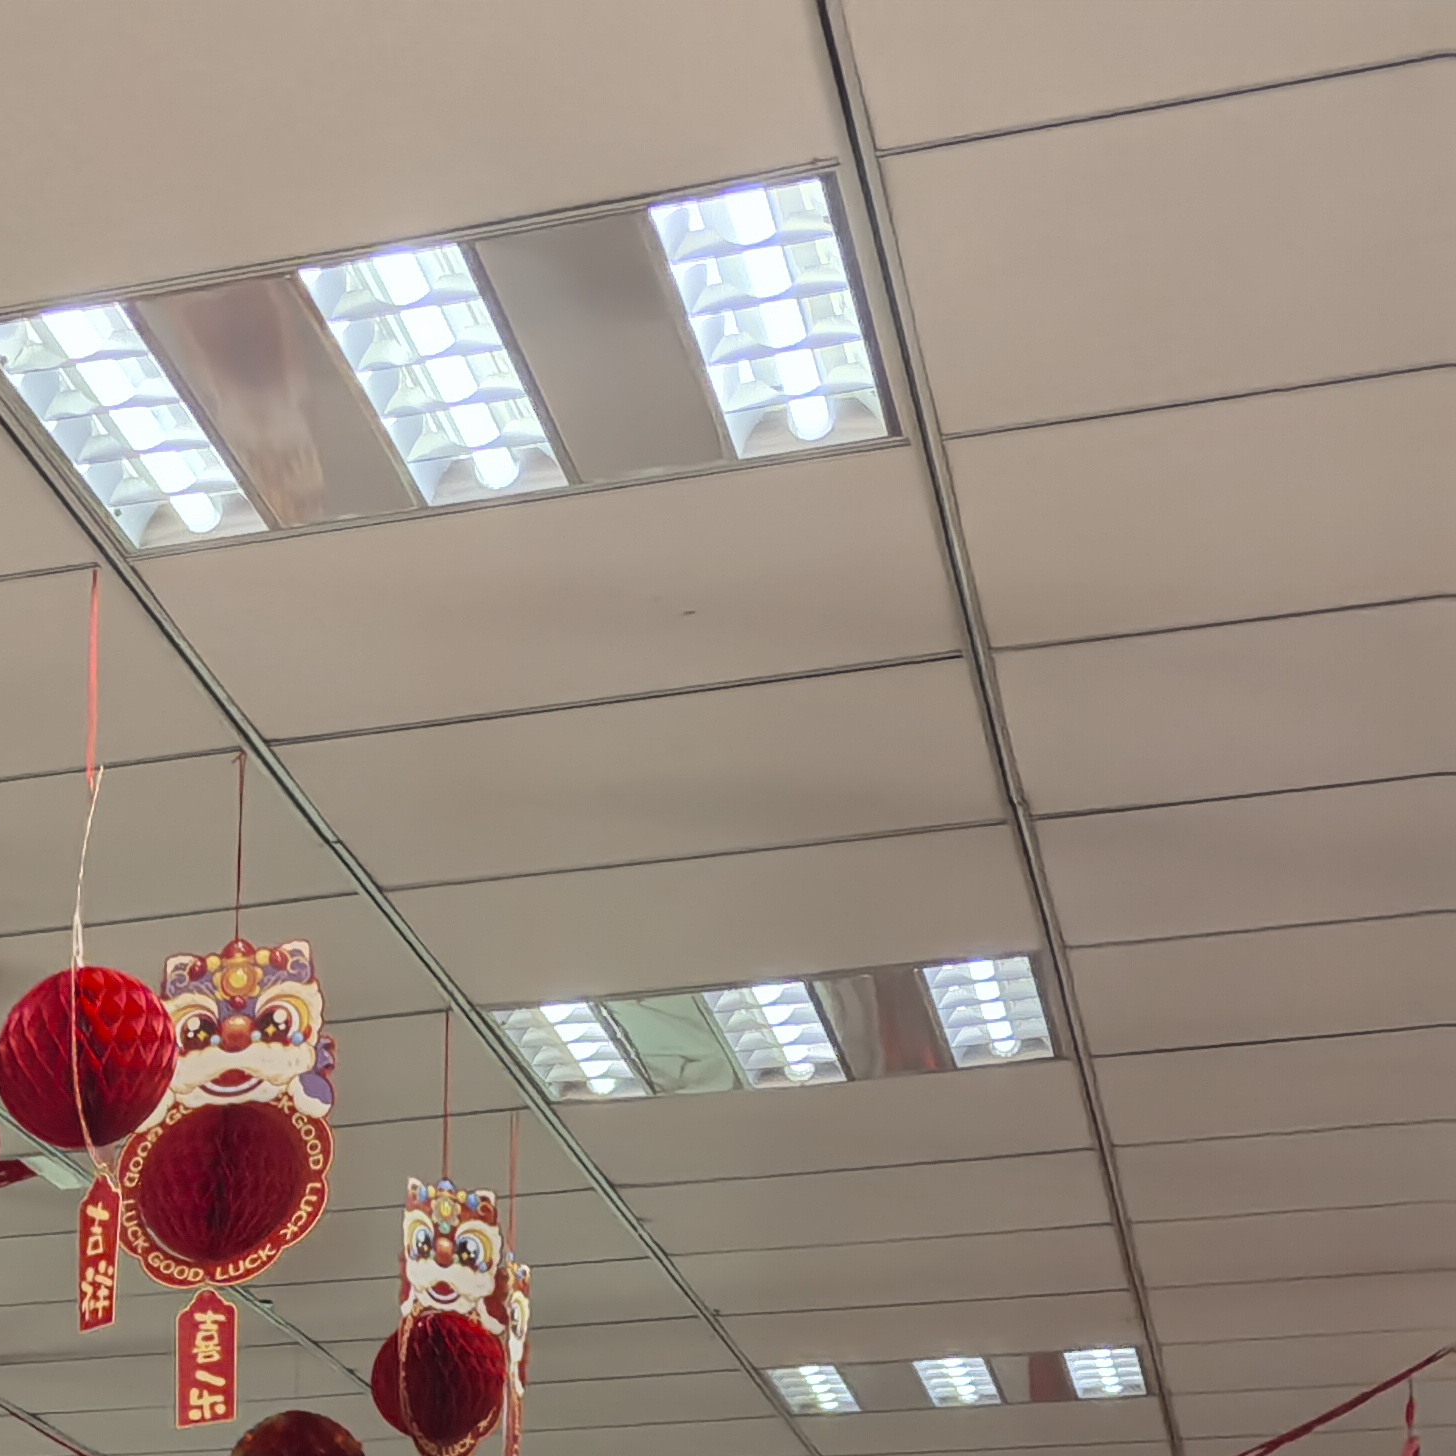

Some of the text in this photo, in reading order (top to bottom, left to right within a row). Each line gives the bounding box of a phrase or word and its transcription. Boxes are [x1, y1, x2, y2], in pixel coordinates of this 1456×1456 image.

[279, 1112, 324, 1240] GOOD LUCK
[81, 1201, 114, 1322] 吉祥
[122, 1198, 151, 1254] LUCK
[147, 1250, 205, 1284] GOOD
[215, 1243, 277, 1282] LUCK
[188, 1308, 227, 1422] 喜乐
